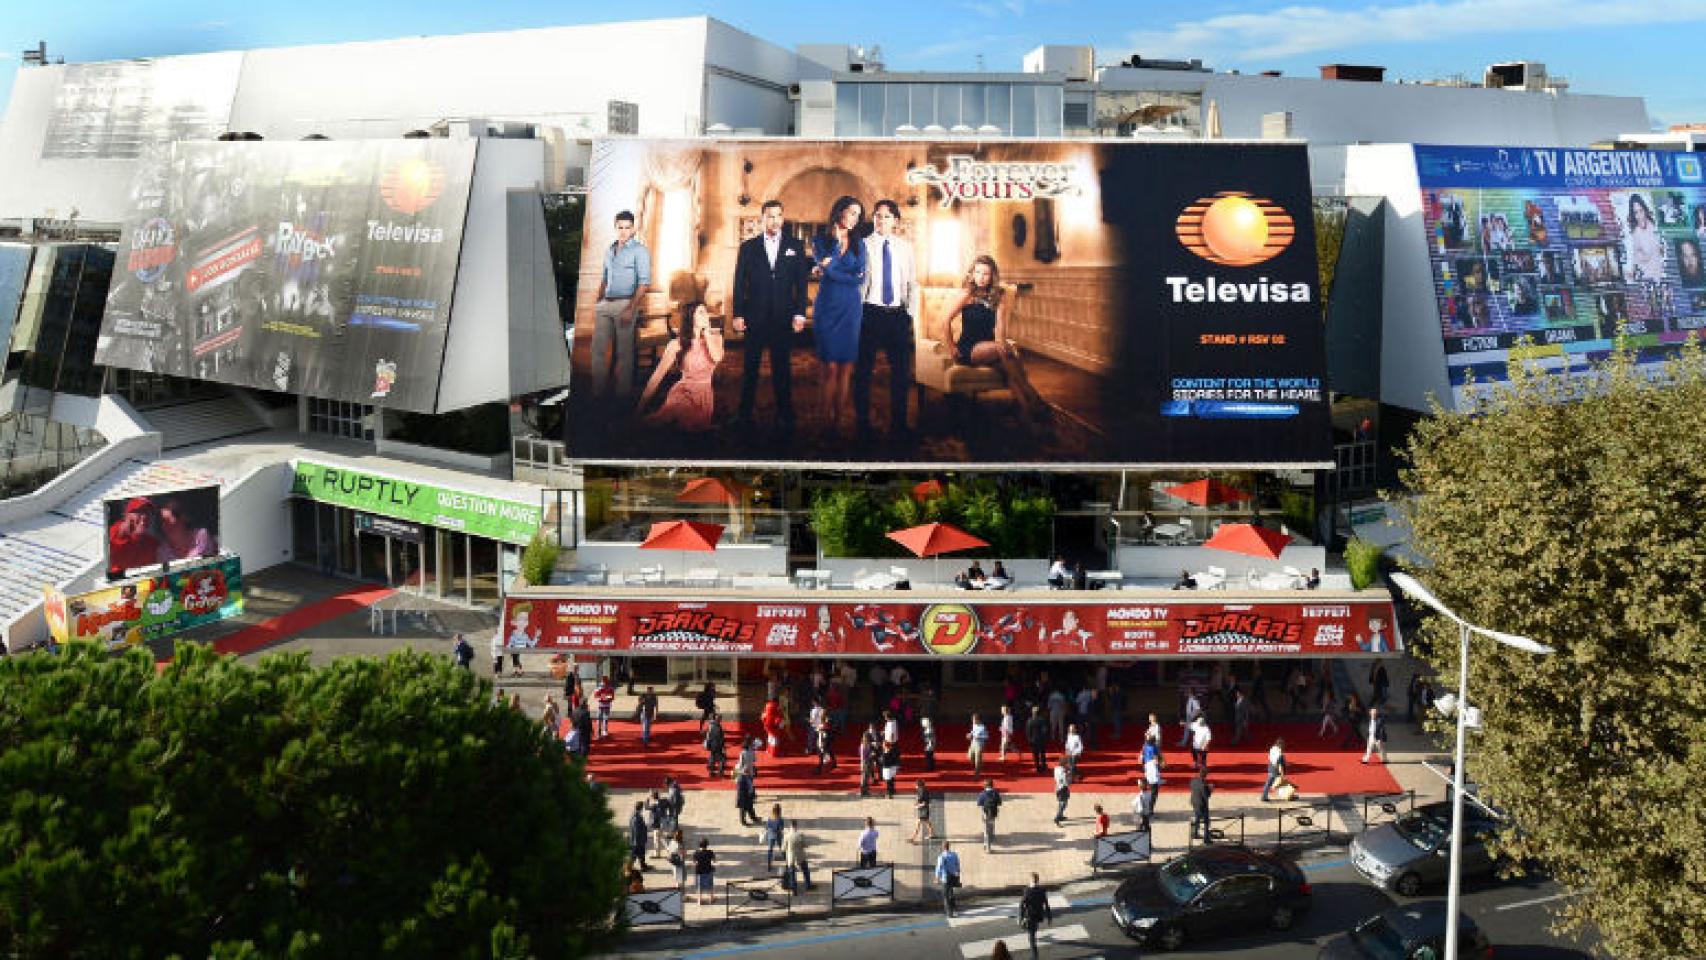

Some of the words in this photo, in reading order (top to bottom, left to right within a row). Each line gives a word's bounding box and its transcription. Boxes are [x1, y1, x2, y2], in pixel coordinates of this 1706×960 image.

[948, 156, 1075, 182] Forever
[1534, 151, 1557, 176] TV
[1564, 151, 1662, 177] ARGENTINA
[940, 181, 1033, 207] yours
[367, 219, 443, 244] Televisa
[1166, 277, 1311, 303] Televisa
[1200, 334, 1236, 345] STAND
[1461, 336, 1498, 351] FICTION
[1172, 378, 1226, 389] CONTENT
[1228, 378, 1251, 389] FOR
[1253, 378, 1277, 389] THE
[1278, 378, 1320, 389] WORLD
[1172, 389, 1225, 401] STORIES
[1226, 389, 1251, 401] FOR
[1254, 389, 1278, 401] THE
[324, 468, 419, 506] RUPTLY
[437, 492, 496, 516] QUESTION
[499, 504, 538, 525] MORE
[557, 604, 602, 615] MONDO
[602, 605, 618, 615] TV
[756, 605, 807, 618] Ferrari
[1106, 608, 1152, 620] MONDO
[1153, 609, 1168, 620] TV
[1302, 605, 1351, 618] Ferrari
[636, 610, 757, 640] DRAKERS
[1182, 613, 1303, 642] DRAKERS
